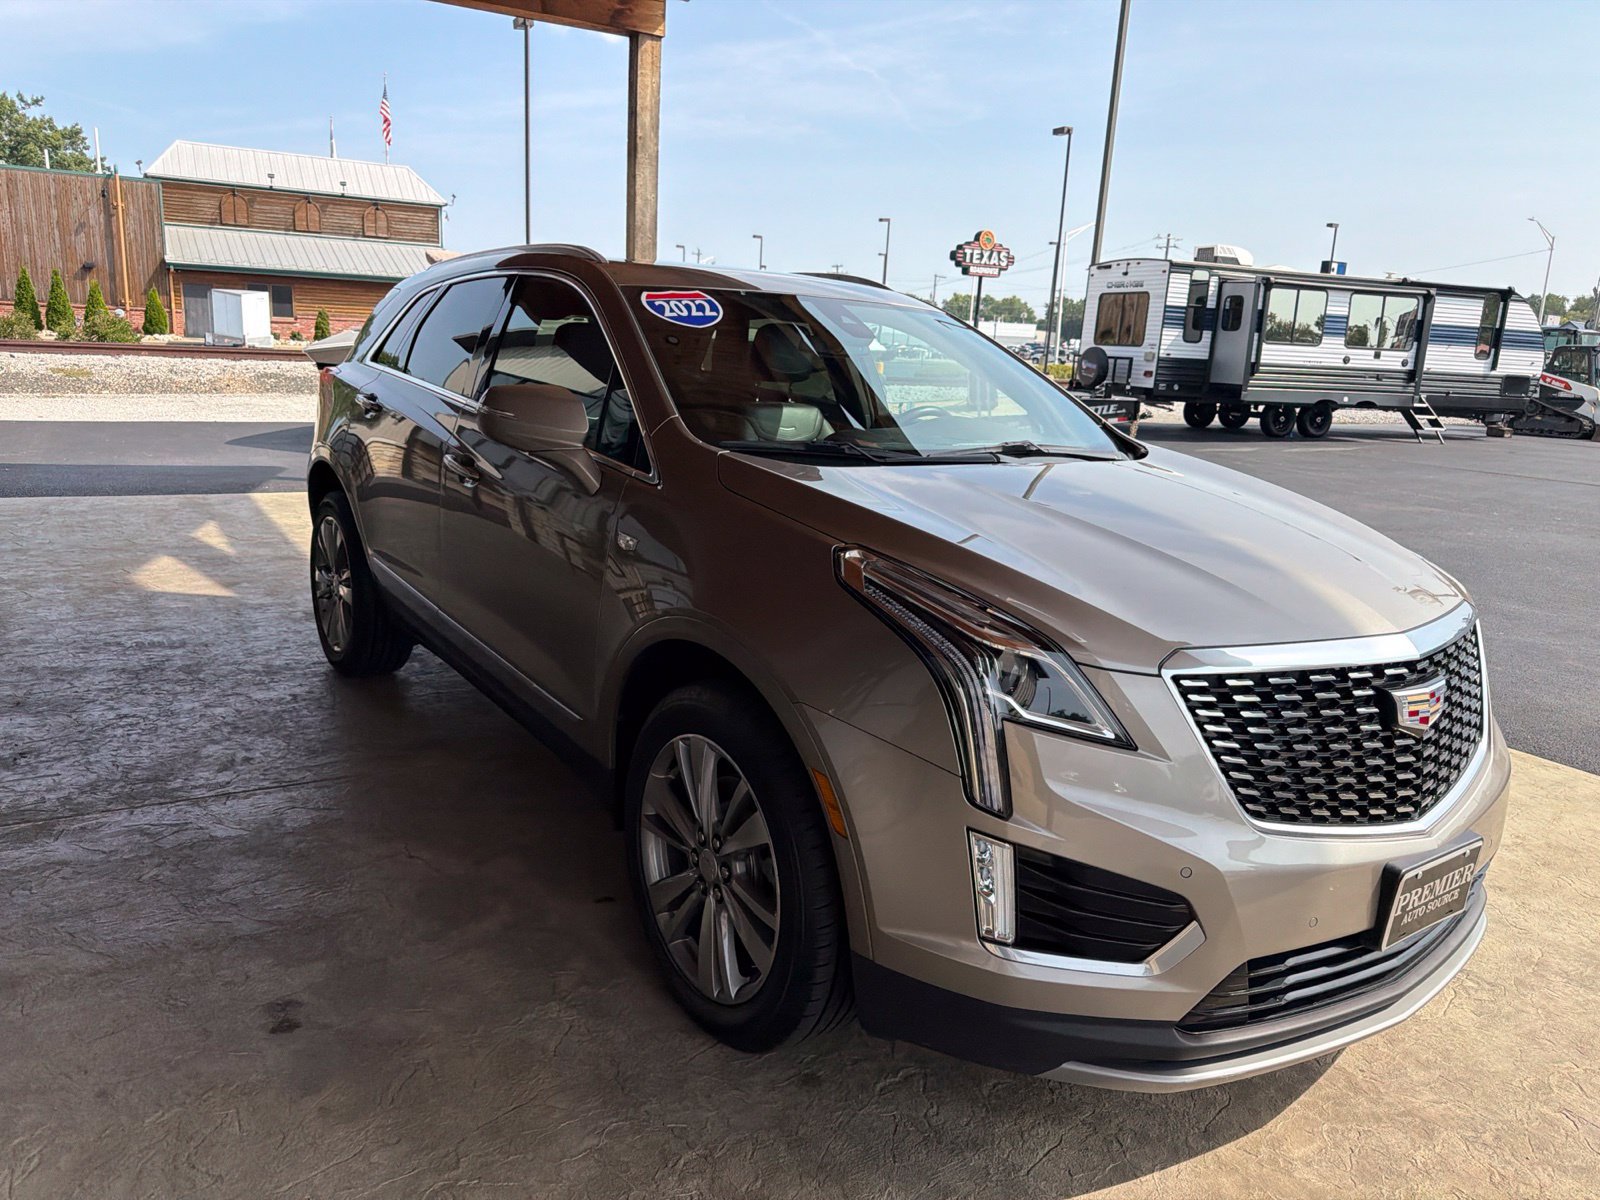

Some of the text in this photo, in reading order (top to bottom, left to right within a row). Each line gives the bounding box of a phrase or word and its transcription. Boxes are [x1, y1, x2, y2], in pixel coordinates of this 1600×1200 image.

[964, 248, 1008, 267] TEXAS
[654, 300, 718, 317] 2022
[1395, 863, 1475, 916] PREMIER
[1401, 888, 1460, 926] AUTO SOURCE
